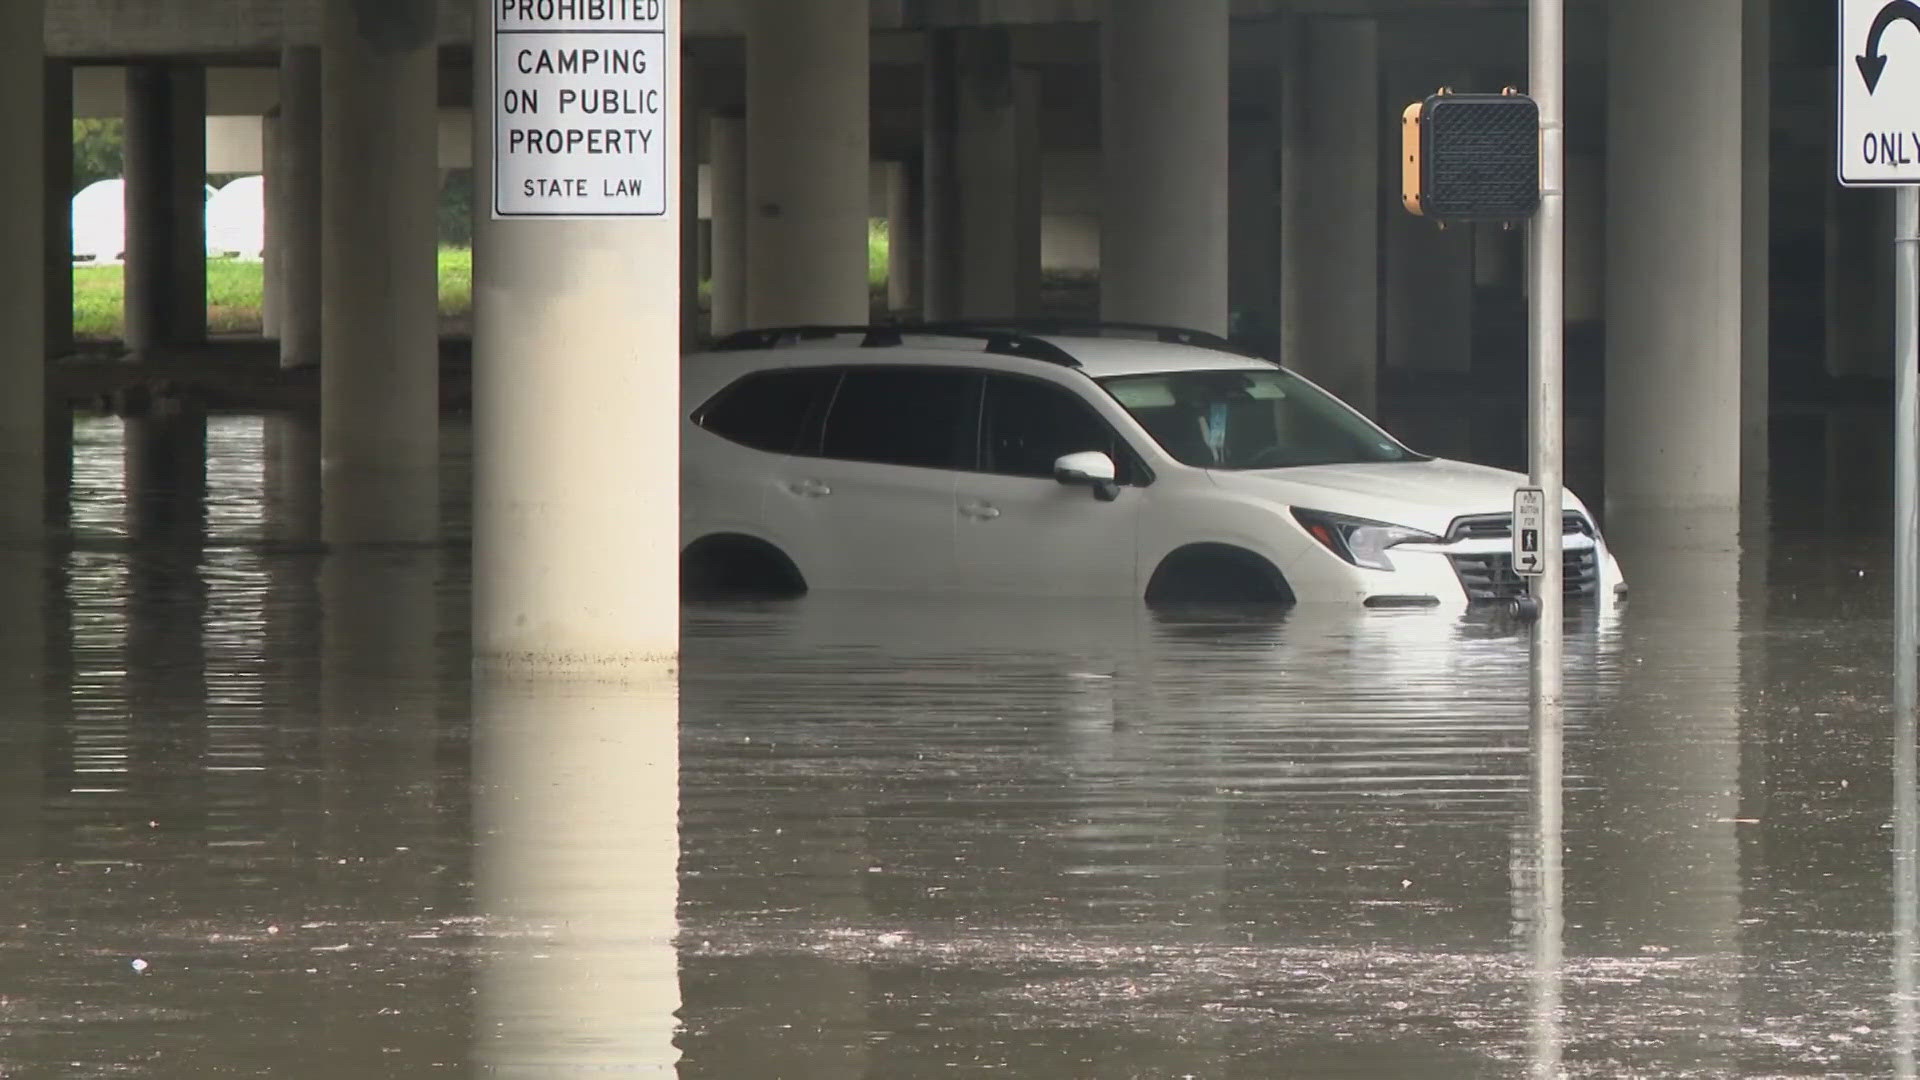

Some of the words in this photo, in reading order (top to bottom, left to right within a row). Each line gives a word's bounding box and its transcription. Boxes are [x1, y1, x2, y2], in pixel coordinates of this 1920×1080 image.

[502, 0, 659, 20] PROHIBITED
[517, 49, 647, 74] CAMPING
[504, 89, 538, 114] ON
[559, 89, 658, 114] PUBLIC
[509, 129, 652, 154] PROPERTY
[523, 179, 588, 197] STATE
[604, 179, 642, 197] LAW
